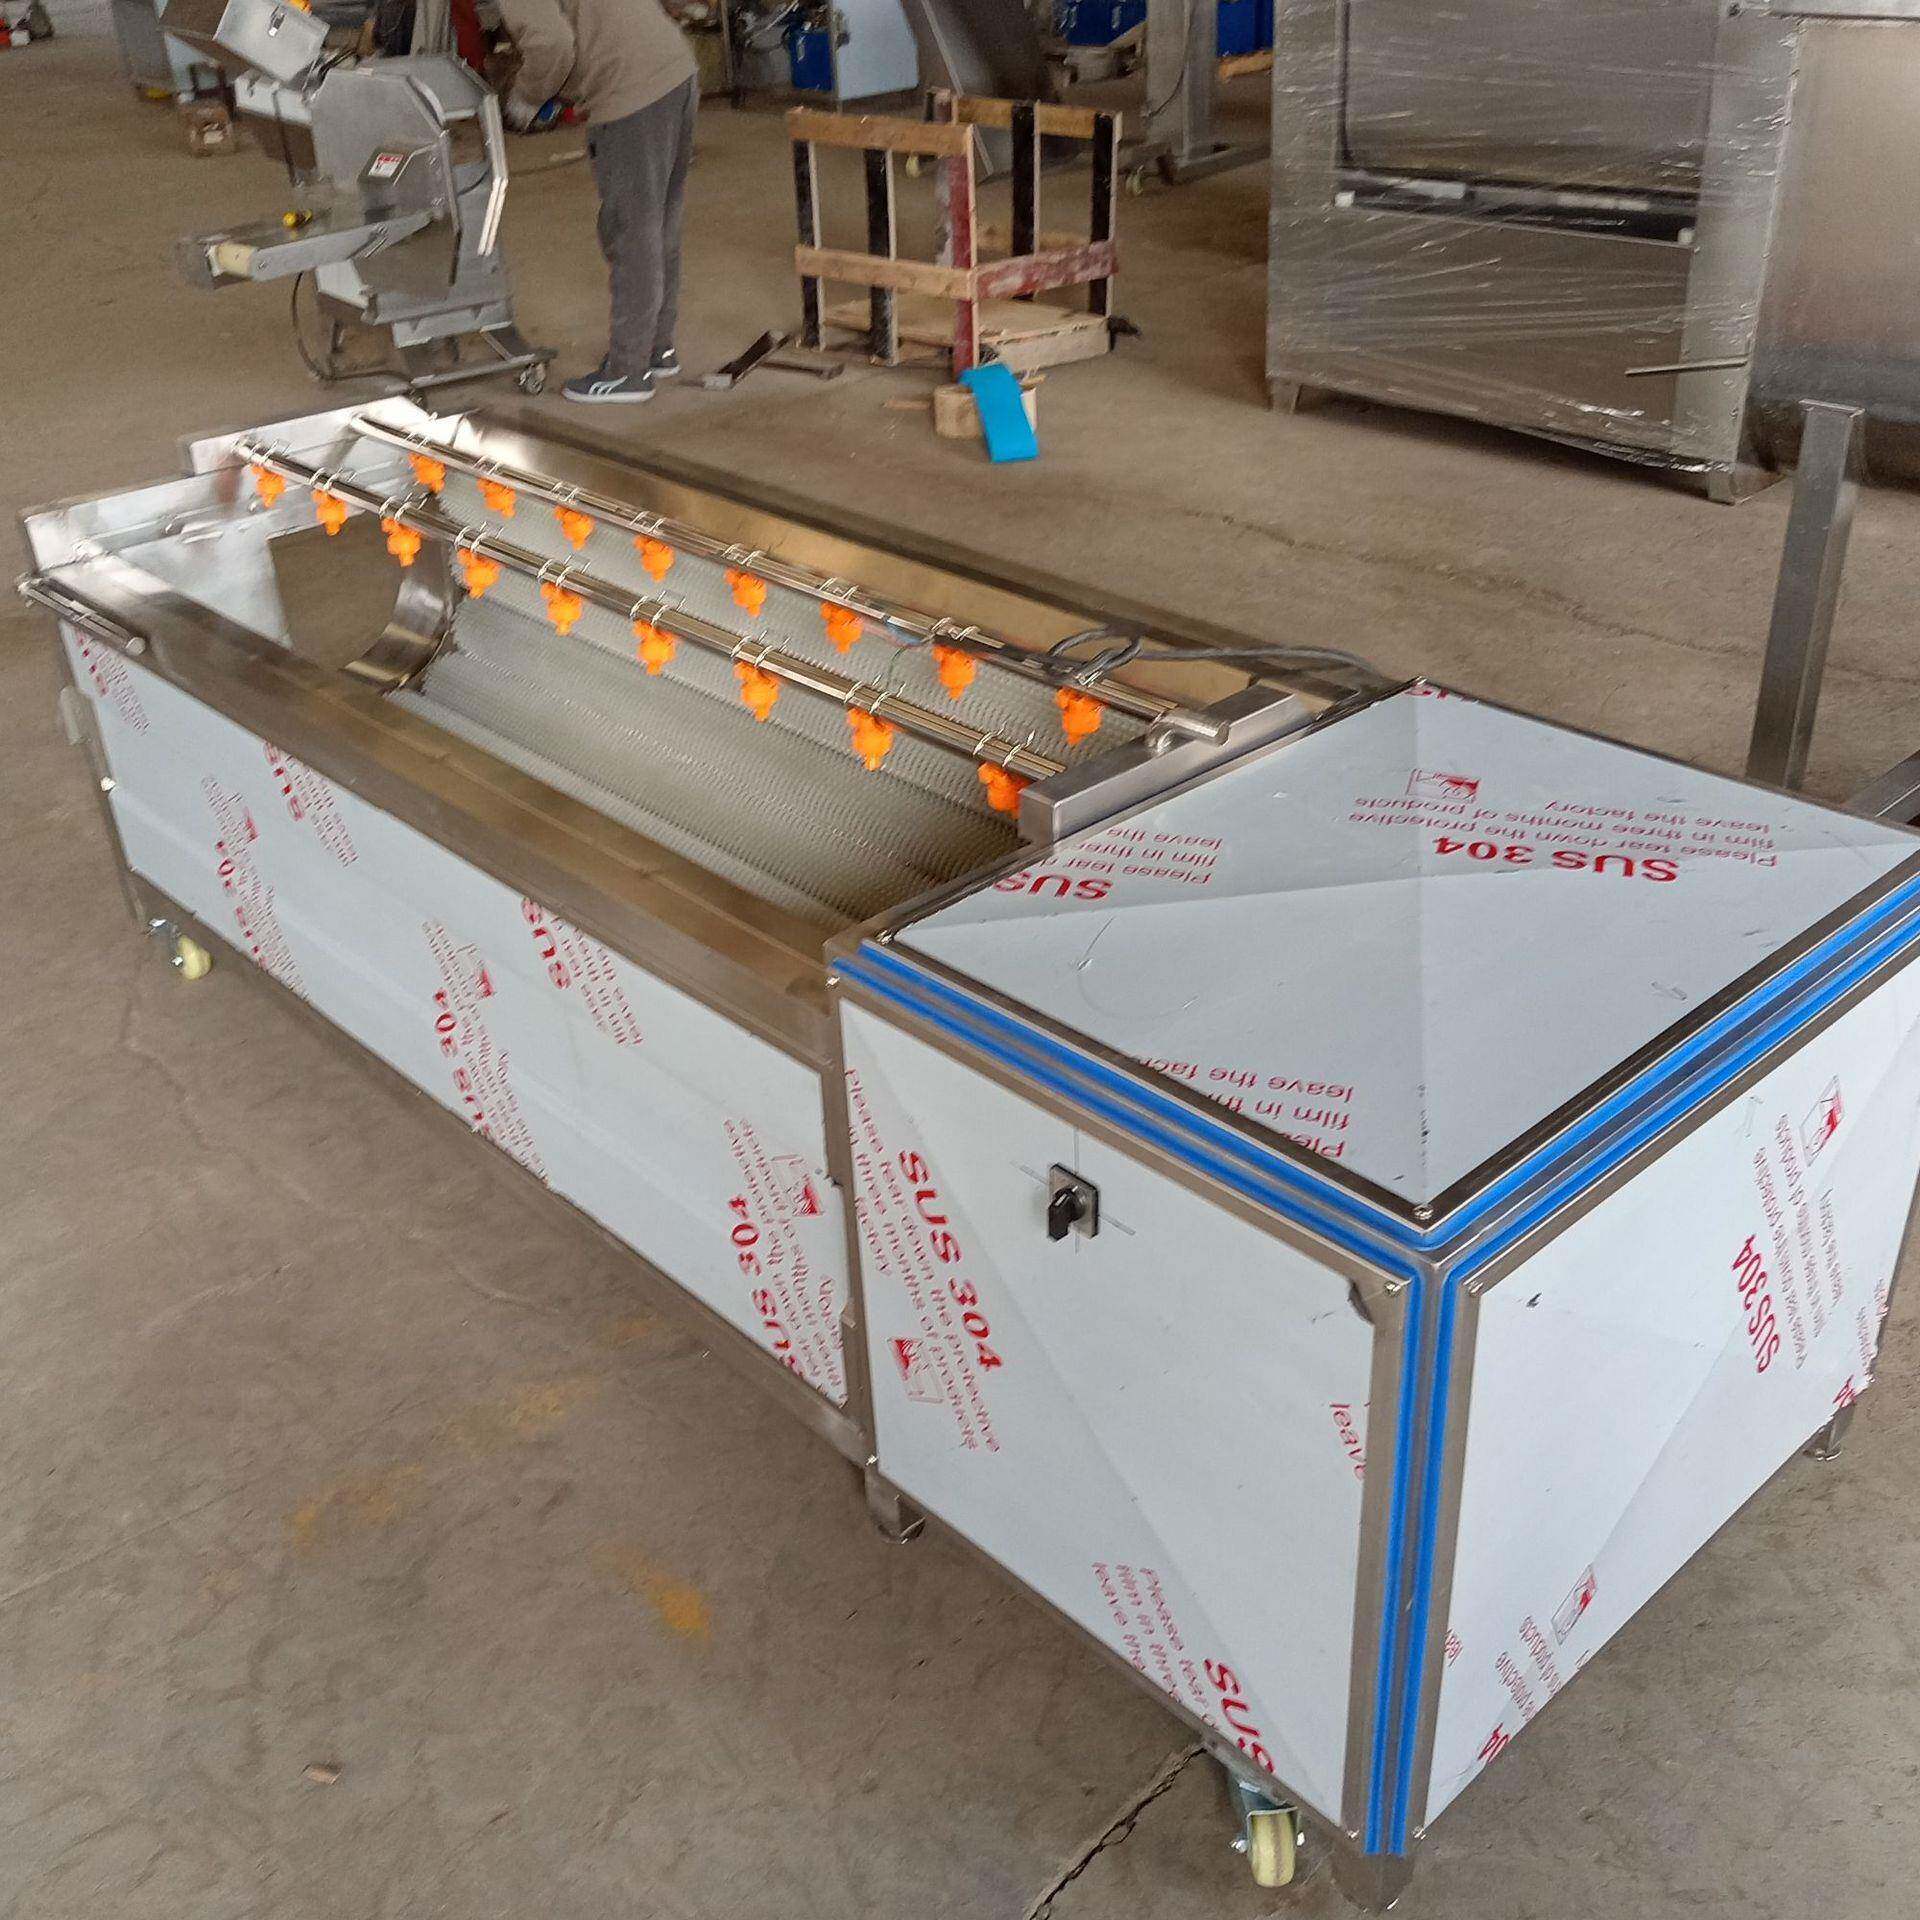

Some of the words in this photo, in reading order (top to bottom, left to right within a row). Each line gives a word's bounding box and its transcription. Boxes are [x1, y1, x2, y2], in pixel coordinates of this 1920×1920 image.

[1474, 809, 1497, 819] of
[1545, 801, 1635, 822] factory
[1644, 813, 1686, 825] the
[1349, 814, 1475, 831] protective
[1507, 813, 1602, 830] months
[1696, 818, 1768, 833] leave
[1107, 826, 1145, 841] the
[1485, 827, 1525, 839] the
[1536, 832, 1607, 847] down
[1612, 825, 1681, 839] three
[1692, 832, 1715, 843] in
[1154, 834, 1222, 850] leave
[1434, 838, 1533, 863] 304
[1621, 841, 1670, 853] tear
[1142, 849, 1164, 860] in
[1172, 852, 1217, 867] film
[1681, 847, 1777, 867] Please
[1063, 858, 1114, 873] tear
[1552, 851, 1678, 881] SUS
[1123, 866, 1211, 884] Please
[1210, 1069, 1256, 1087] the
[1268, 1077, 1353, 1102] leave
[1256, 1101, 1282, 1119] in
[1293, 1107, 1349, 1130] film
[899, 1151, 961, 1263] SUS
[949, 1279, 1001, 1371] 304
[1733, 1235, 1767, 1310] 304
[1749, 1294, 1779, 1373] SUS
[1205, 1659, 1274, 1775] SUS
